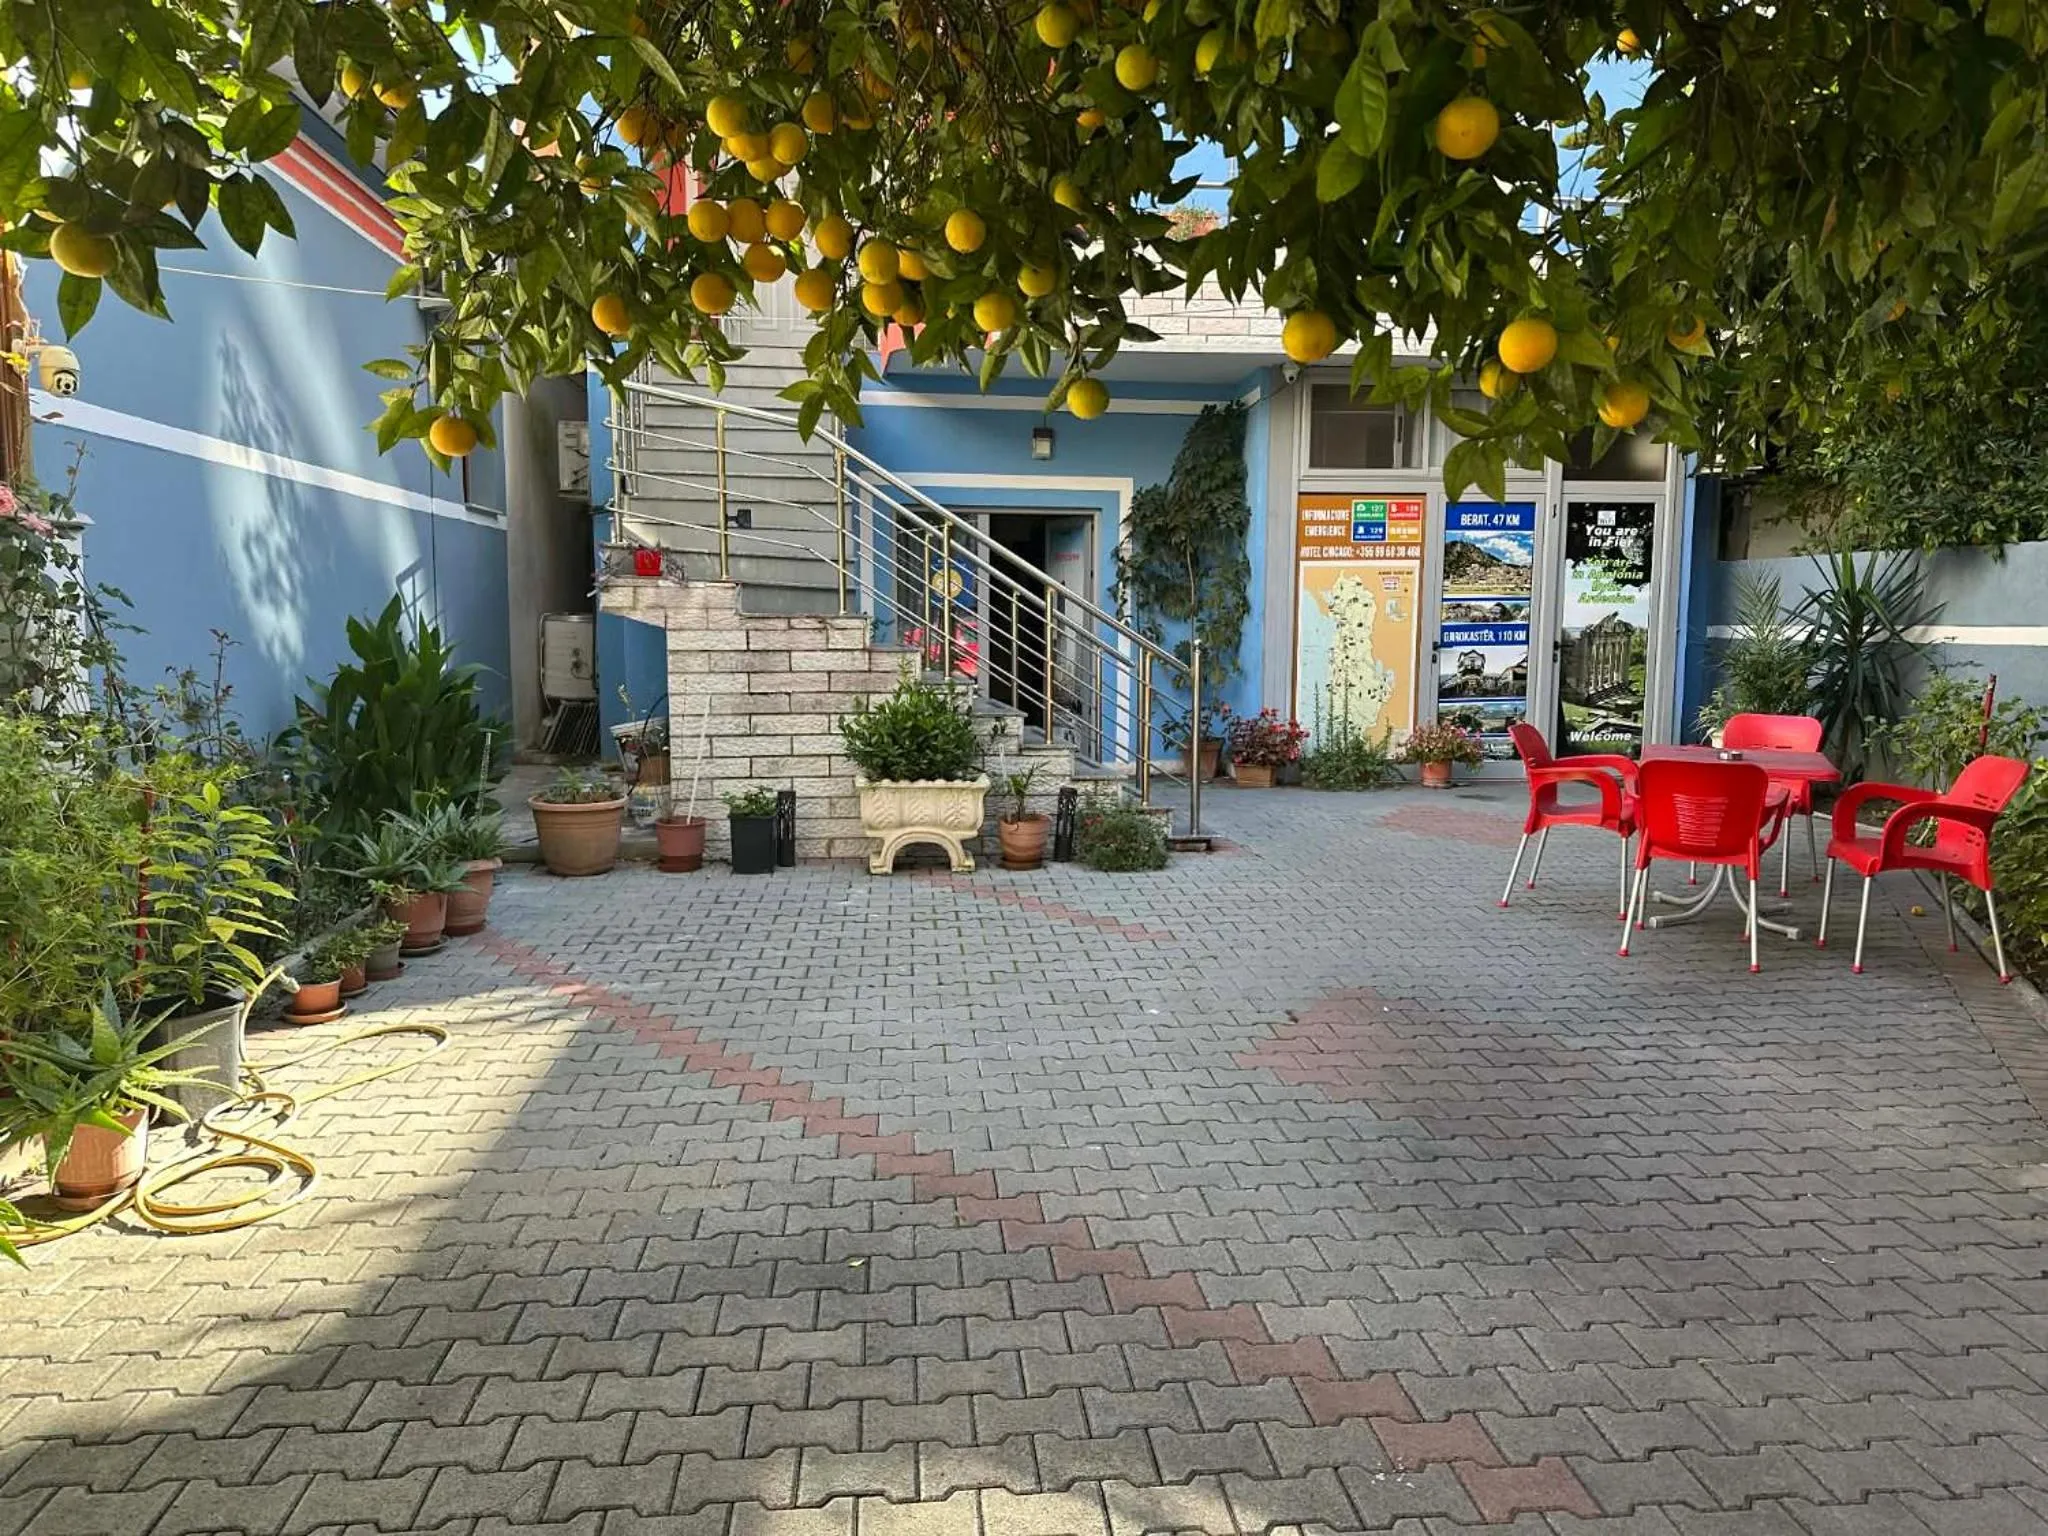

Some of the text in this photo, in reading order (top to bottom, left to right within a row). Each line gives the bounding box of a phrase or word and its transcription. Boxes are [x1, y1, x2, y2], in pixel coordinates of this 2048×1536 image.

[1492, 513, 1505, 526] 47
[1505, 513, 1520, 526] KM
[1585, 524, 1638, 536] You are
[1588, 535, 1633, 547] in Fier
[1586, 557, 1609, 567] You
[1513, 630, 1526, 641] KM
[1570, 731, 1632, 742] Welcome
